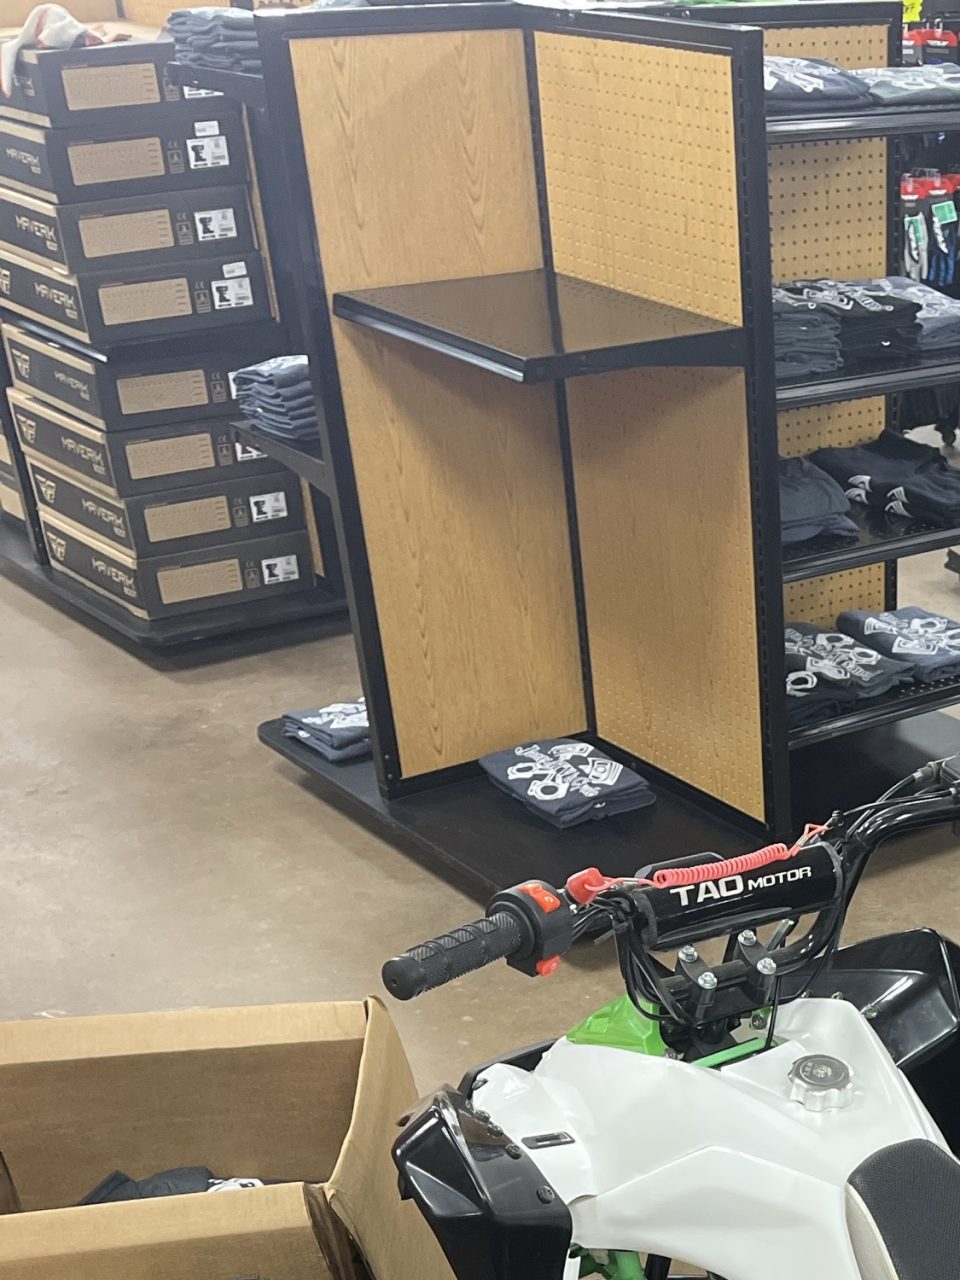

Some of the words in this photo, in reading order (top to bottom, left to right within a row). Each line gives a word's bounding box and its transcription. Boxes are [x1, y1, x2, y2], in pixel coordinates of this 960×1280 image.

[16, 215, 56, 242] MAVERIK
[34, 282, 76, 310] MAVERIK
[61, 437, 105, 467] MAVERIK
[81, 498, 125, 529] MAVERIK
[91, 558, 136, 590] MAVERIK
[669, 874, 744, 906] TAO
[747, 866, 812, 890] MOTOR
